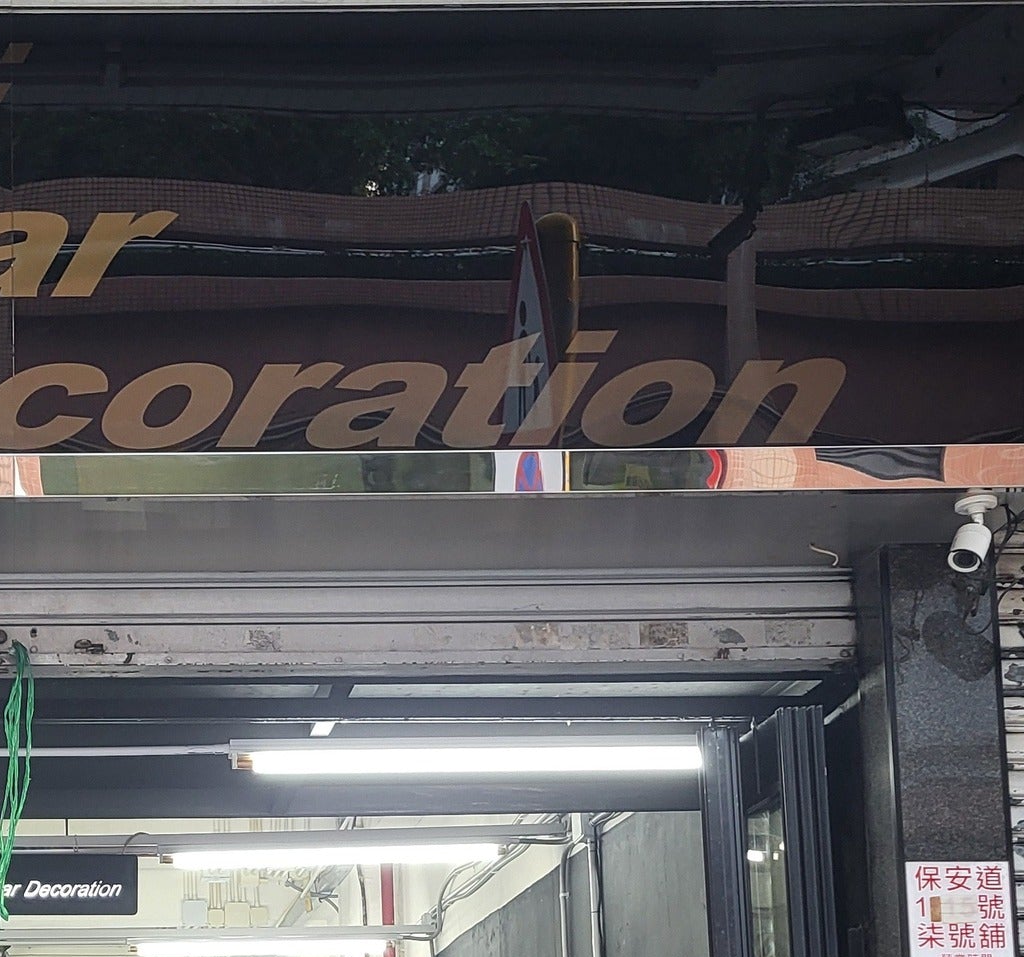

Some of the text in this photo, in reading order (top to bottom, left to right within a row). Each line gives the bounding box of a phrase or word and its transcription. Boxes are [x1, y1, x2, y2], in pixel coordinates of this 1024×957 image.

[24, 880, 123, 898] Decoration
[915, 865, 1004, 892] 保安道
[917, 923, 1006, 949] 柒號舖
